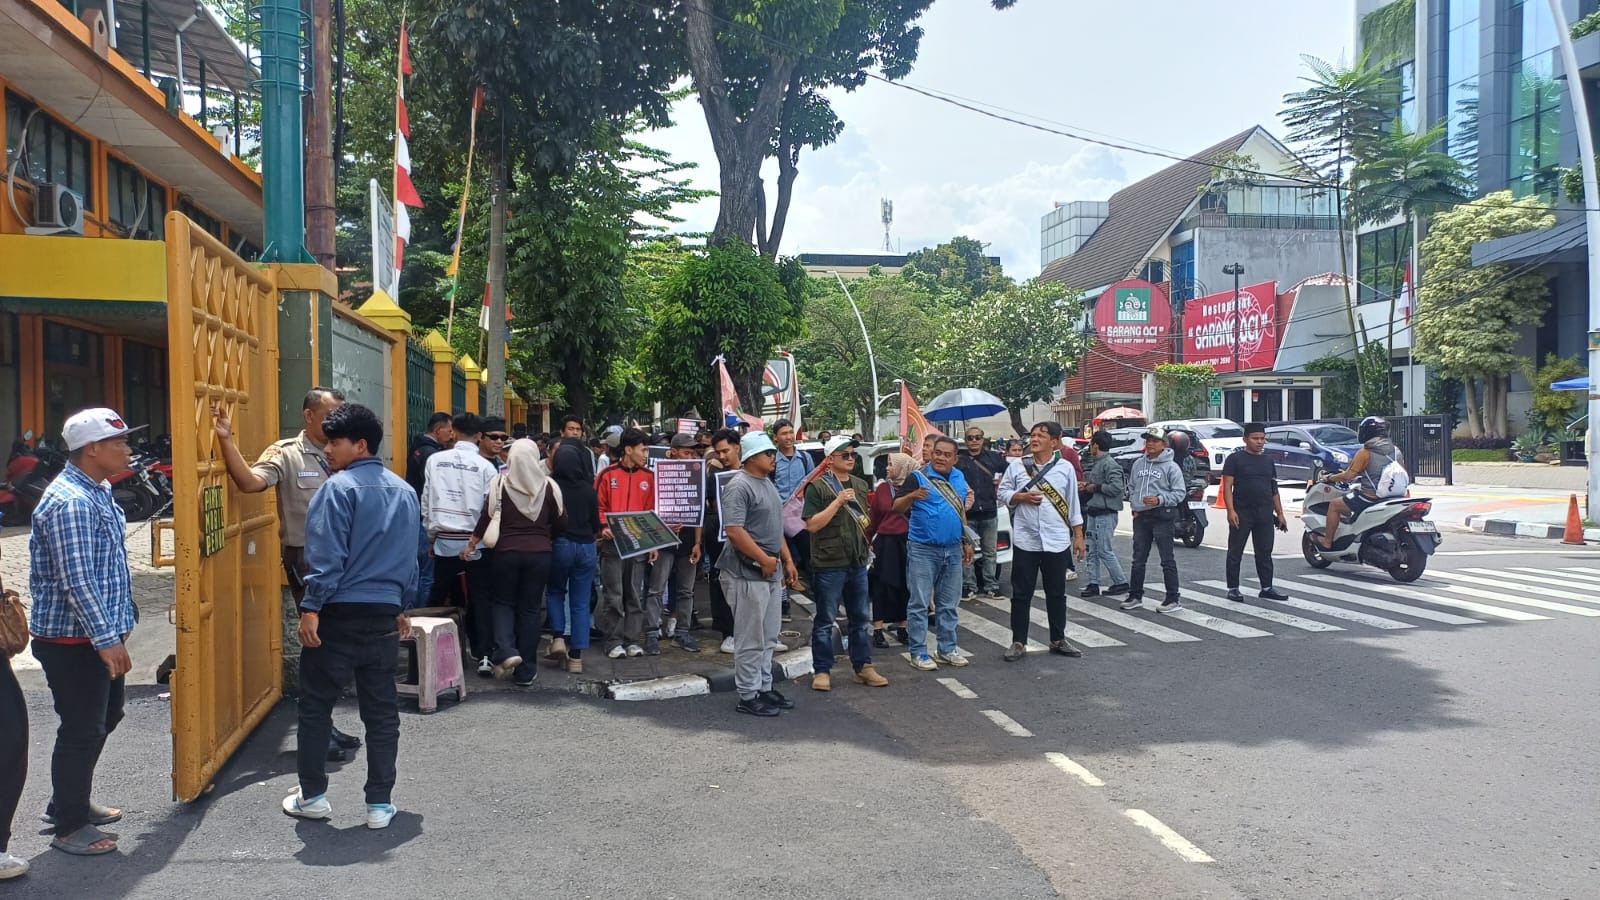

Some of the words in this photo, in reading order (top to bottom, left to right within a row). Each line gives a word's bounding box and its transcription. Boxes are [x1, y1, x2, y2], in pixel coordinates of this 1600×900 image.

[1107, 326, 1141, 337] SARANG
[1143, 326, 1158, 336] OCI
[1239, 315, 1259, 342] OCI
